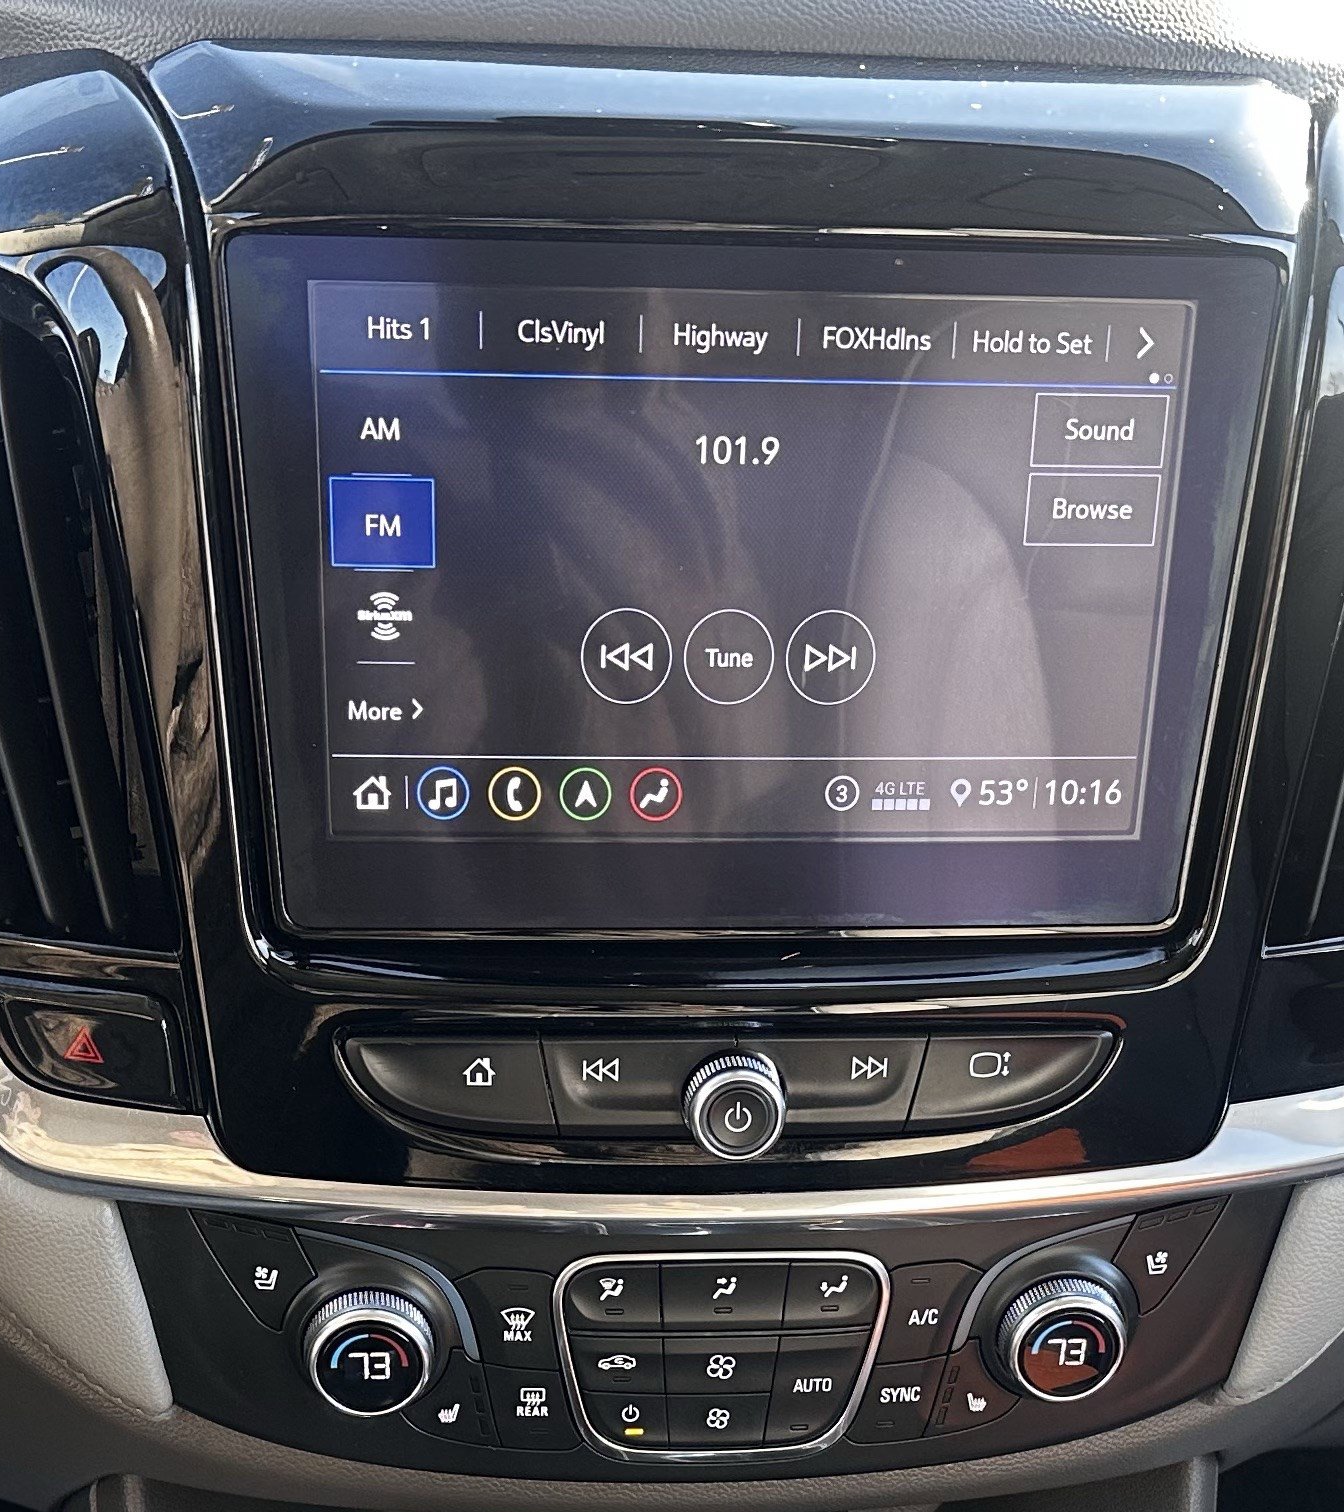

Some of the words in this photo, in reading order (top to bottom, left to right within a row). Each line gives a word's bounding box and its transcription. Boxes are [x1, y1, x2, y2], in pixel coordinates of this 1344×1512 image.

[367, 316, 413, 340] Hits
[419, 317, 430, 340] 1
[673, 323, 768, 355] Highway
[973, 330, 1023, 354] Hold
[1029, 332, 1051, 354] to
[1056, 332, 1093, 355] Set
[360, 417, 401, 441] AM
[1064, 418, 1135, 442] Sound
[695, 435, 780, 466] 101.9
[1053, 497, 1133, 521] Browse
[365, 514, 401, 537] FM
[704, 648, 754, 670] Tune
[348, 700, 403, 721] More
[835, 785, 848, 803] 3
[874, 781, 895, 795] 4G
[899, 782, 925, 795] LTE
[1046, 779, 1122, 806] 10:16
[908, 1309, 939, 1327] A/C
[503, 1330, 533, 1342] MAX
[1048, 1338, 1087, 1367] 73
[348, 1352, 391, 1381] 73
[793, 1377, 833, 1394] AUTO
[880, 1386, 921, 1404] SYNC
[516, 1406, 549, 1418] REAR
